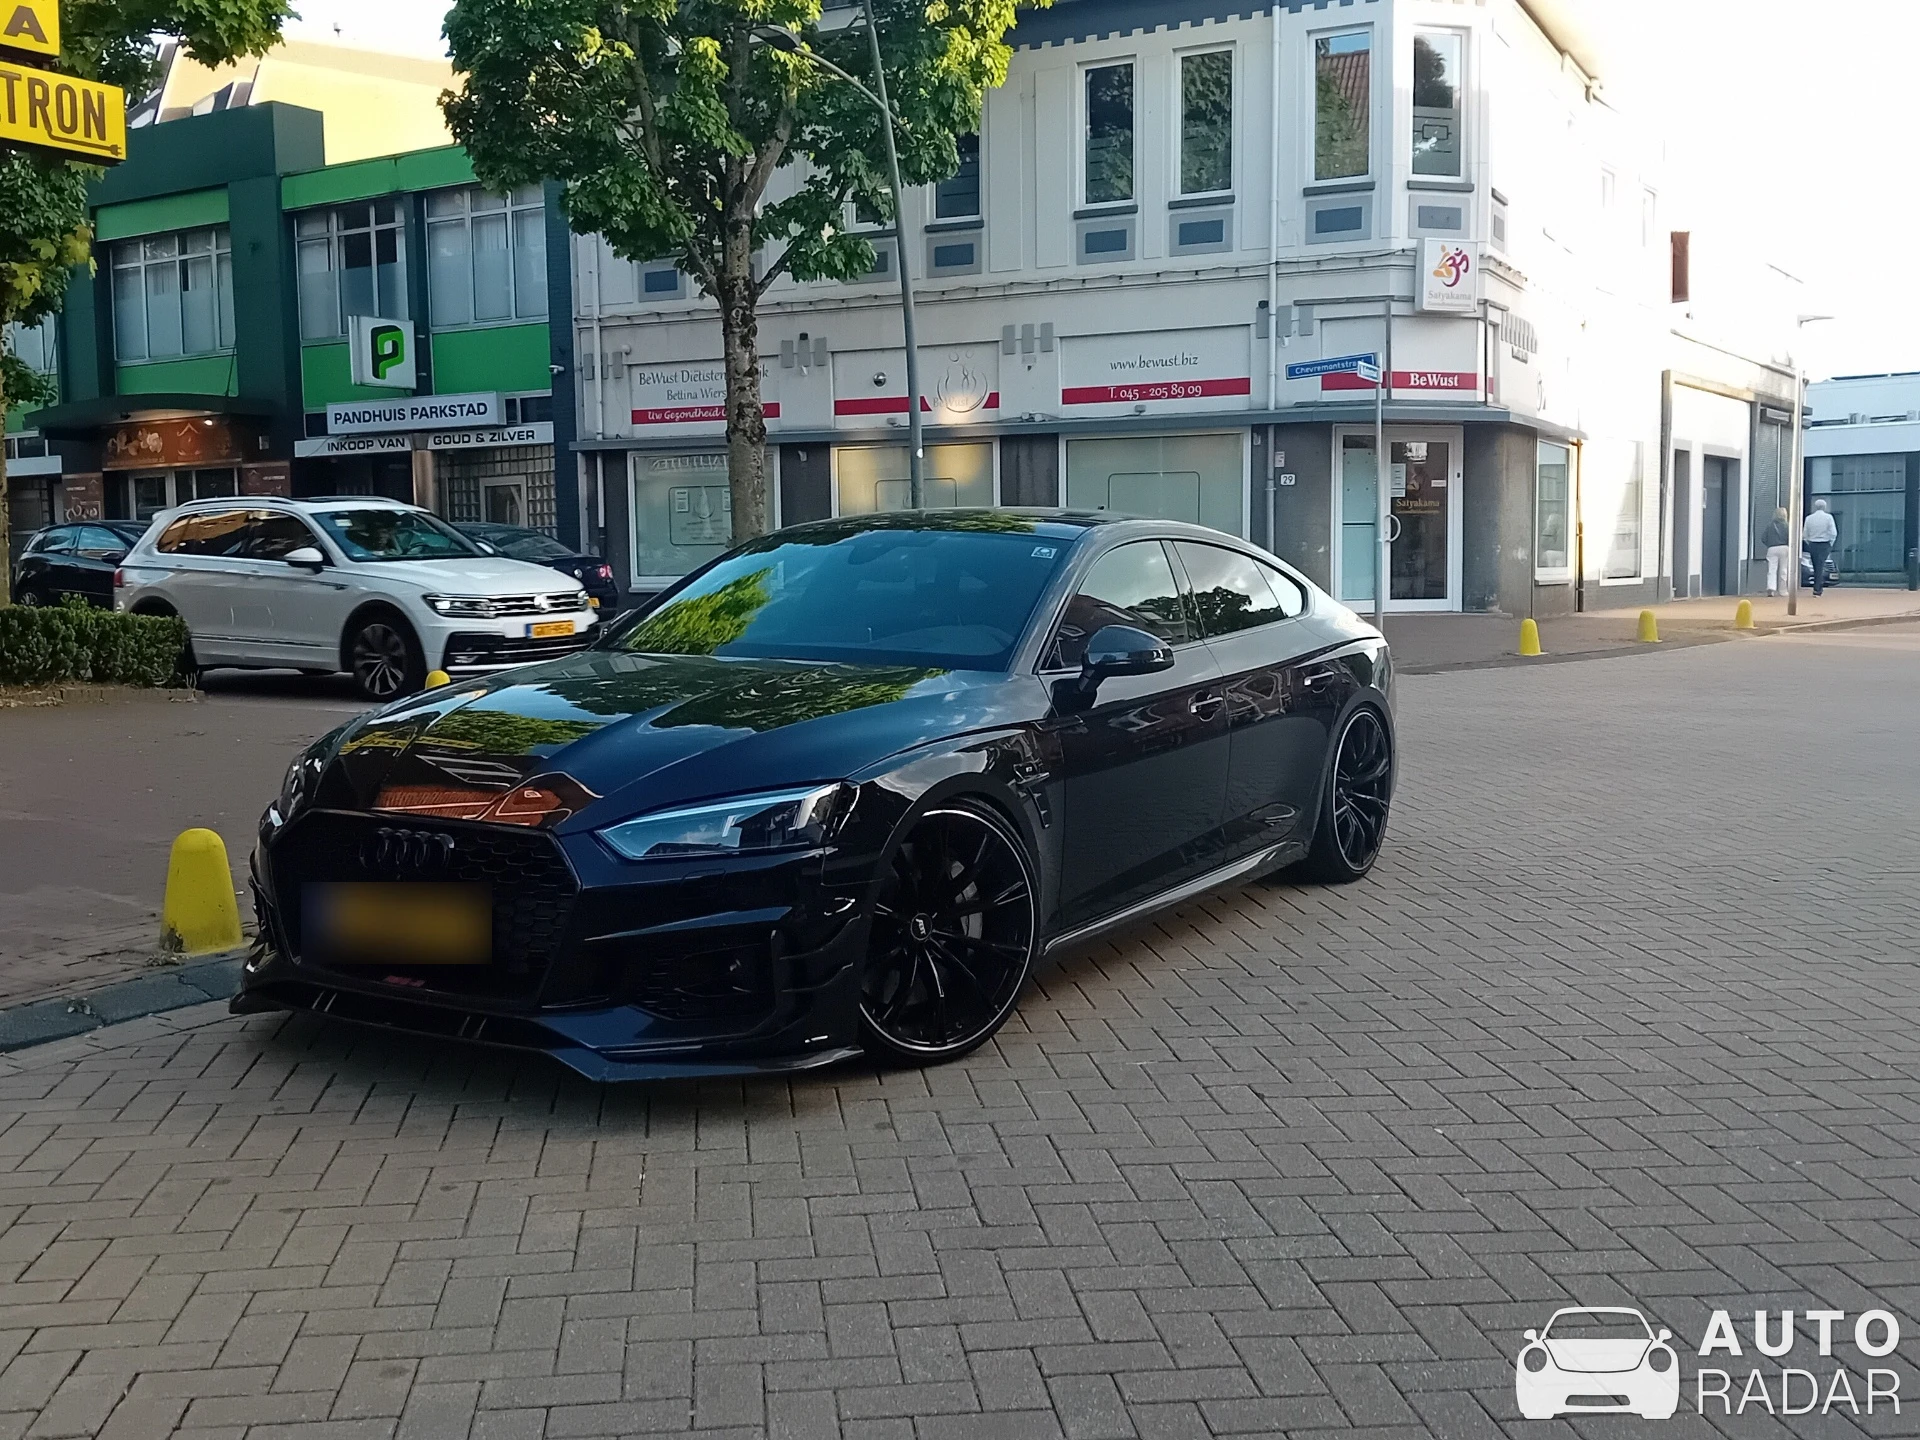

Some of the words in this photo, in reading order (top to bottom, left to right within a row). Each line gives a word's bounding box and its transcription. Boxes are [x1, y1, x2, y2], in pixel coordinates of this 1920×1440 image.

[0, 70, 106, 141] TRON
[1428, 291, 1471, 300] Satyakama
[1109, 352, 1199, 370] www.bewust.biz
[1295, 357, 1364, 374] Chevremontstra
[639, 372, 678, 385] BeWust
[1409, 373, 1459, 387] BeWust
[667, 389, 698, 400] Bettina
[700, 387, 728, 399] Wiers
[1108, 386, 1117, 399] T.
[1120, 388, 1139, 401] 045
[1149, 387, 1168, 400] 205
[1171, 383, 1185, 397] 89
[1187, 385, 1202, 397] 09
[334, 408, 406, 425] PANDHUIS
[410, 402, 488, 420] PARKSTAD
[648, 411, 662, 420] Uw
[664, 407, 720, 421] Gezondheid
[327, 440, 374, 452] INKOOP
[377, 437, 405, 449] VAN
[433, 434, 471, 446] GOUD
[475, 433, 485, 443] &
[489, 430, 535, 442] ZILVER
[1282, 475, 1294, 485] 29
[1396, 499, 1440, 510] Satyakama
